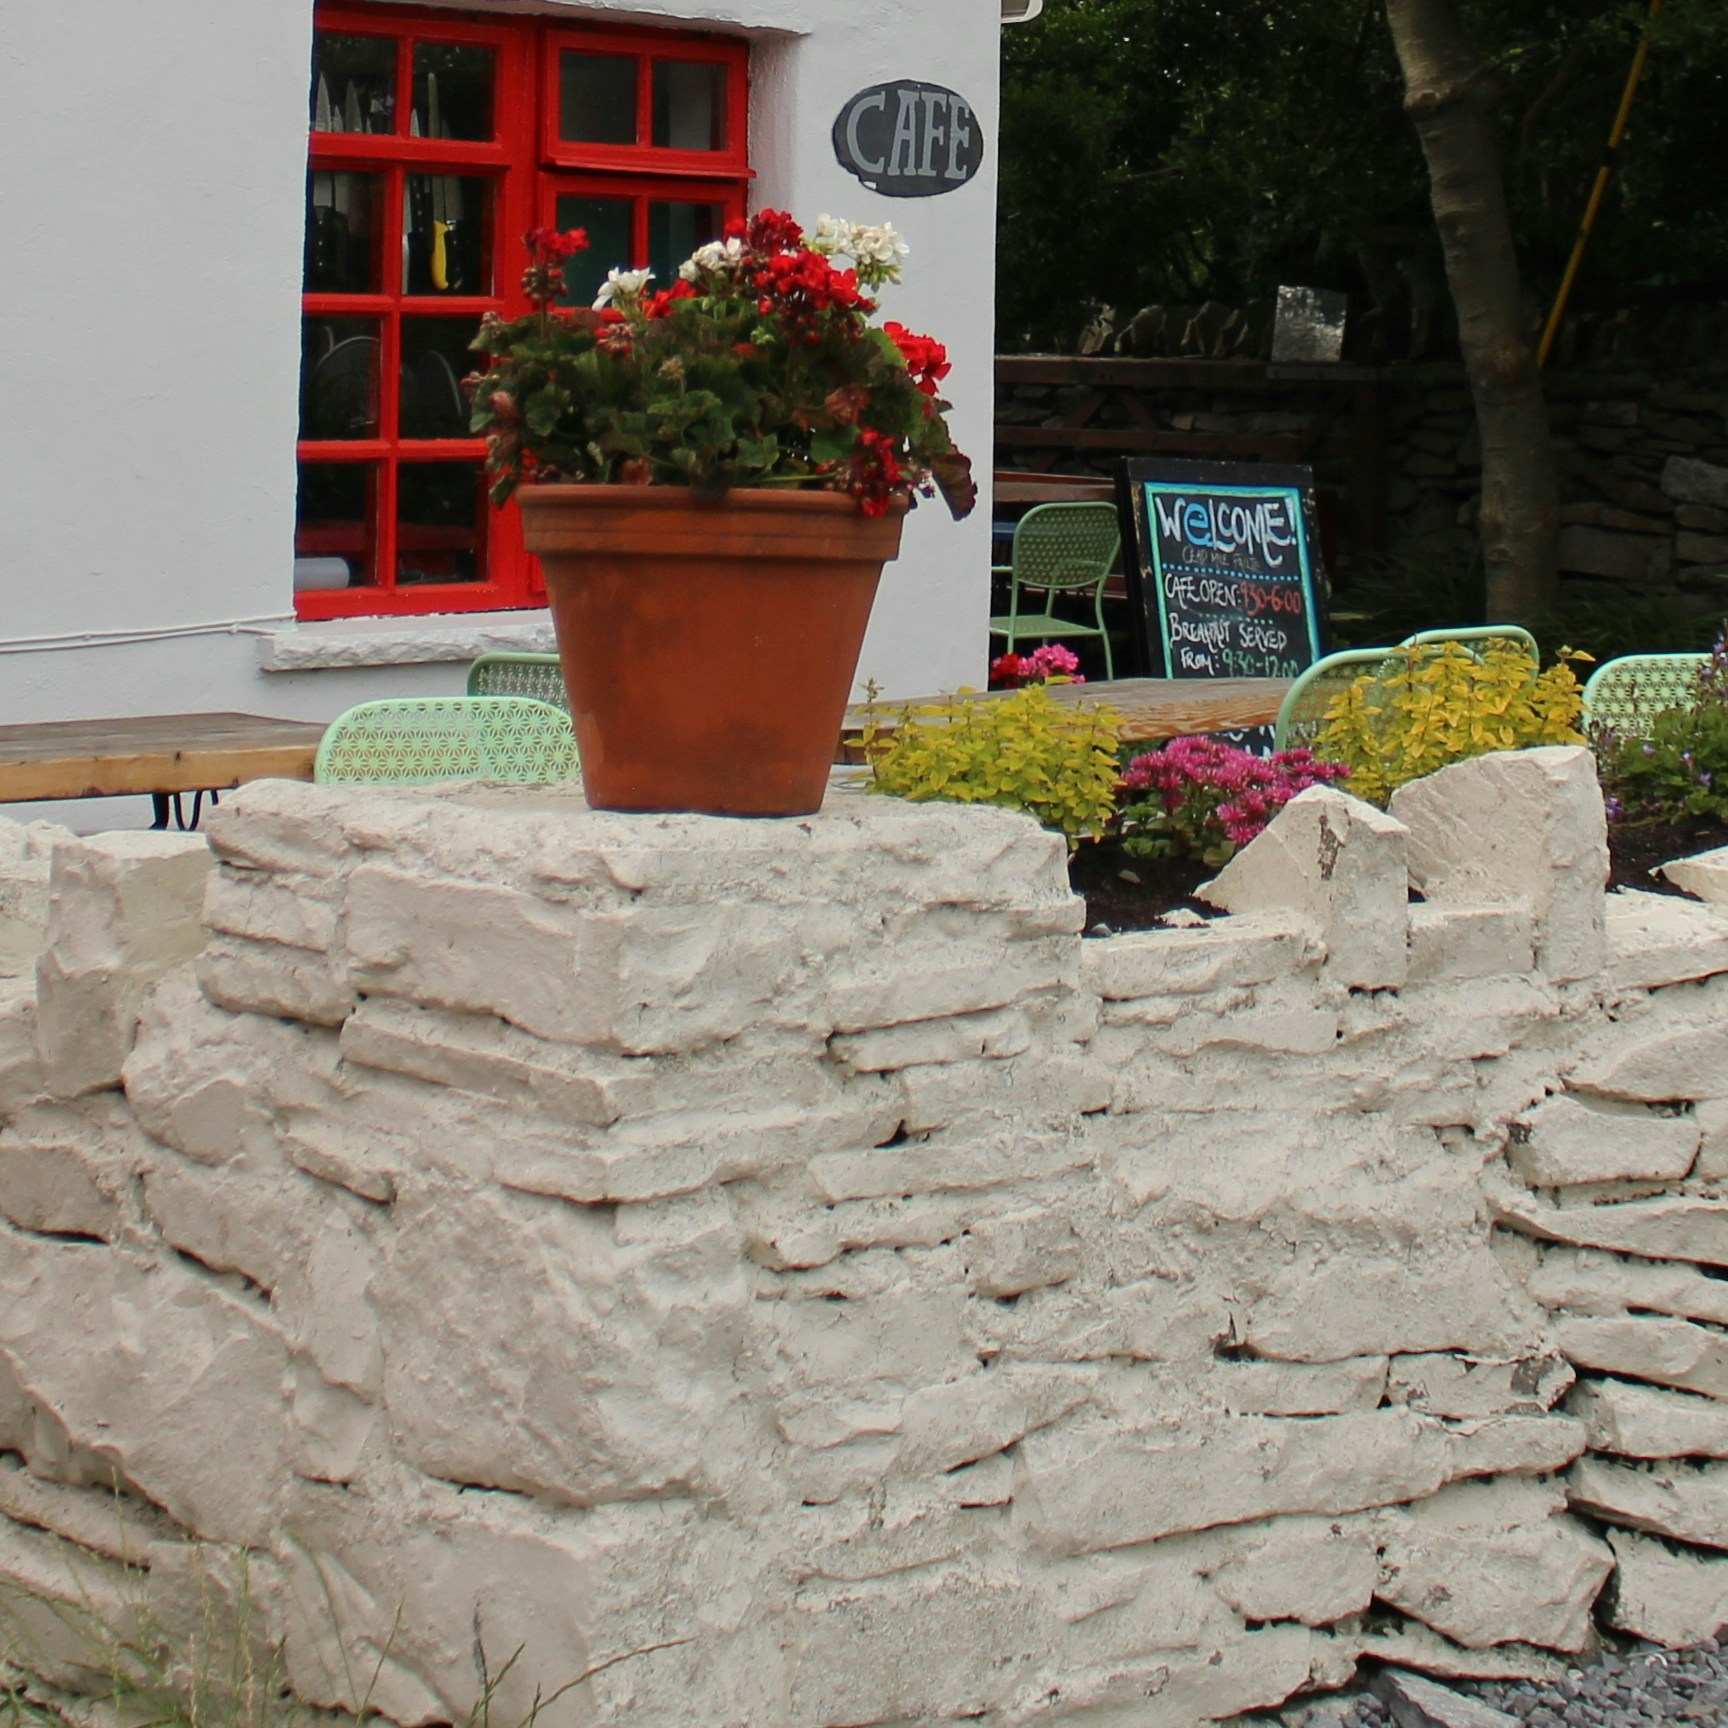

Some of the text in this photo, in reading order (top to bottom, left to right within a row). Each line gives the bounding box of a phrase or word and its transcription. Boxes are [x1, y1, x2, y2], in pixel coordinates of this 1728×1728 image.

[846, 89, 970, 180] CAFE
[1164, 572, 1200, 610] CAFE
[1238, 623, 1288, 653] SERVED
